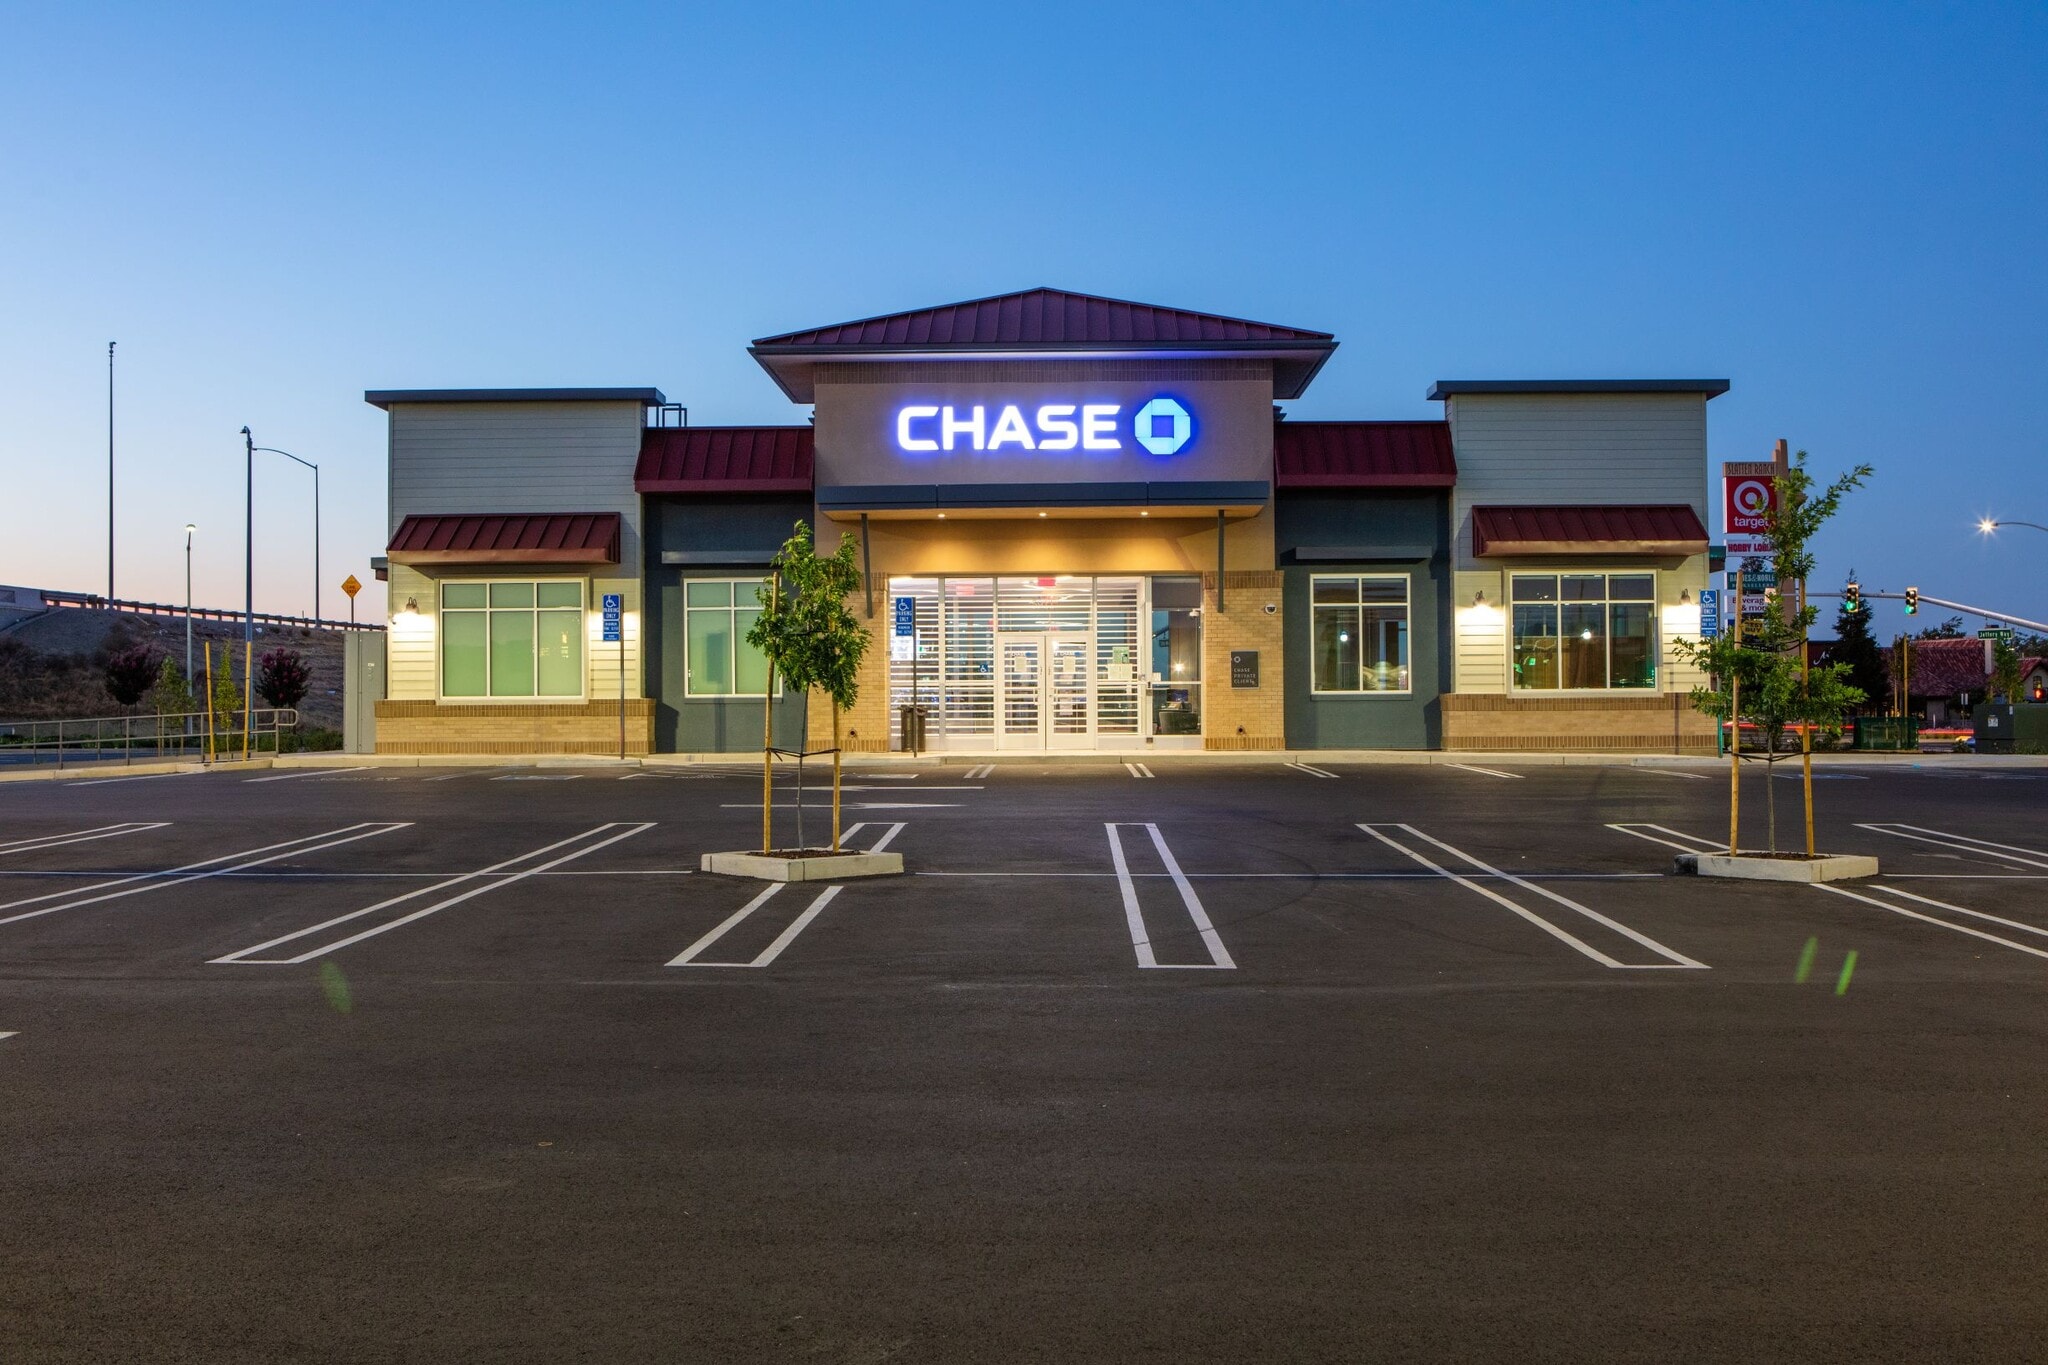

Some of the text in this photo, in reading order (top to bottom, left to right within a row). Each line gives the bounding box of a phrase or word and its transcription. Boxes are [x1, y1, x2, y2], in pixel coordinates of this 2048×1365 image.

[897, 405, 1121, 451] CHASE
[1728, 463, 1775, 475] SLATTEN RANCH
[1728, 543, 1751, 552] HOBBY
